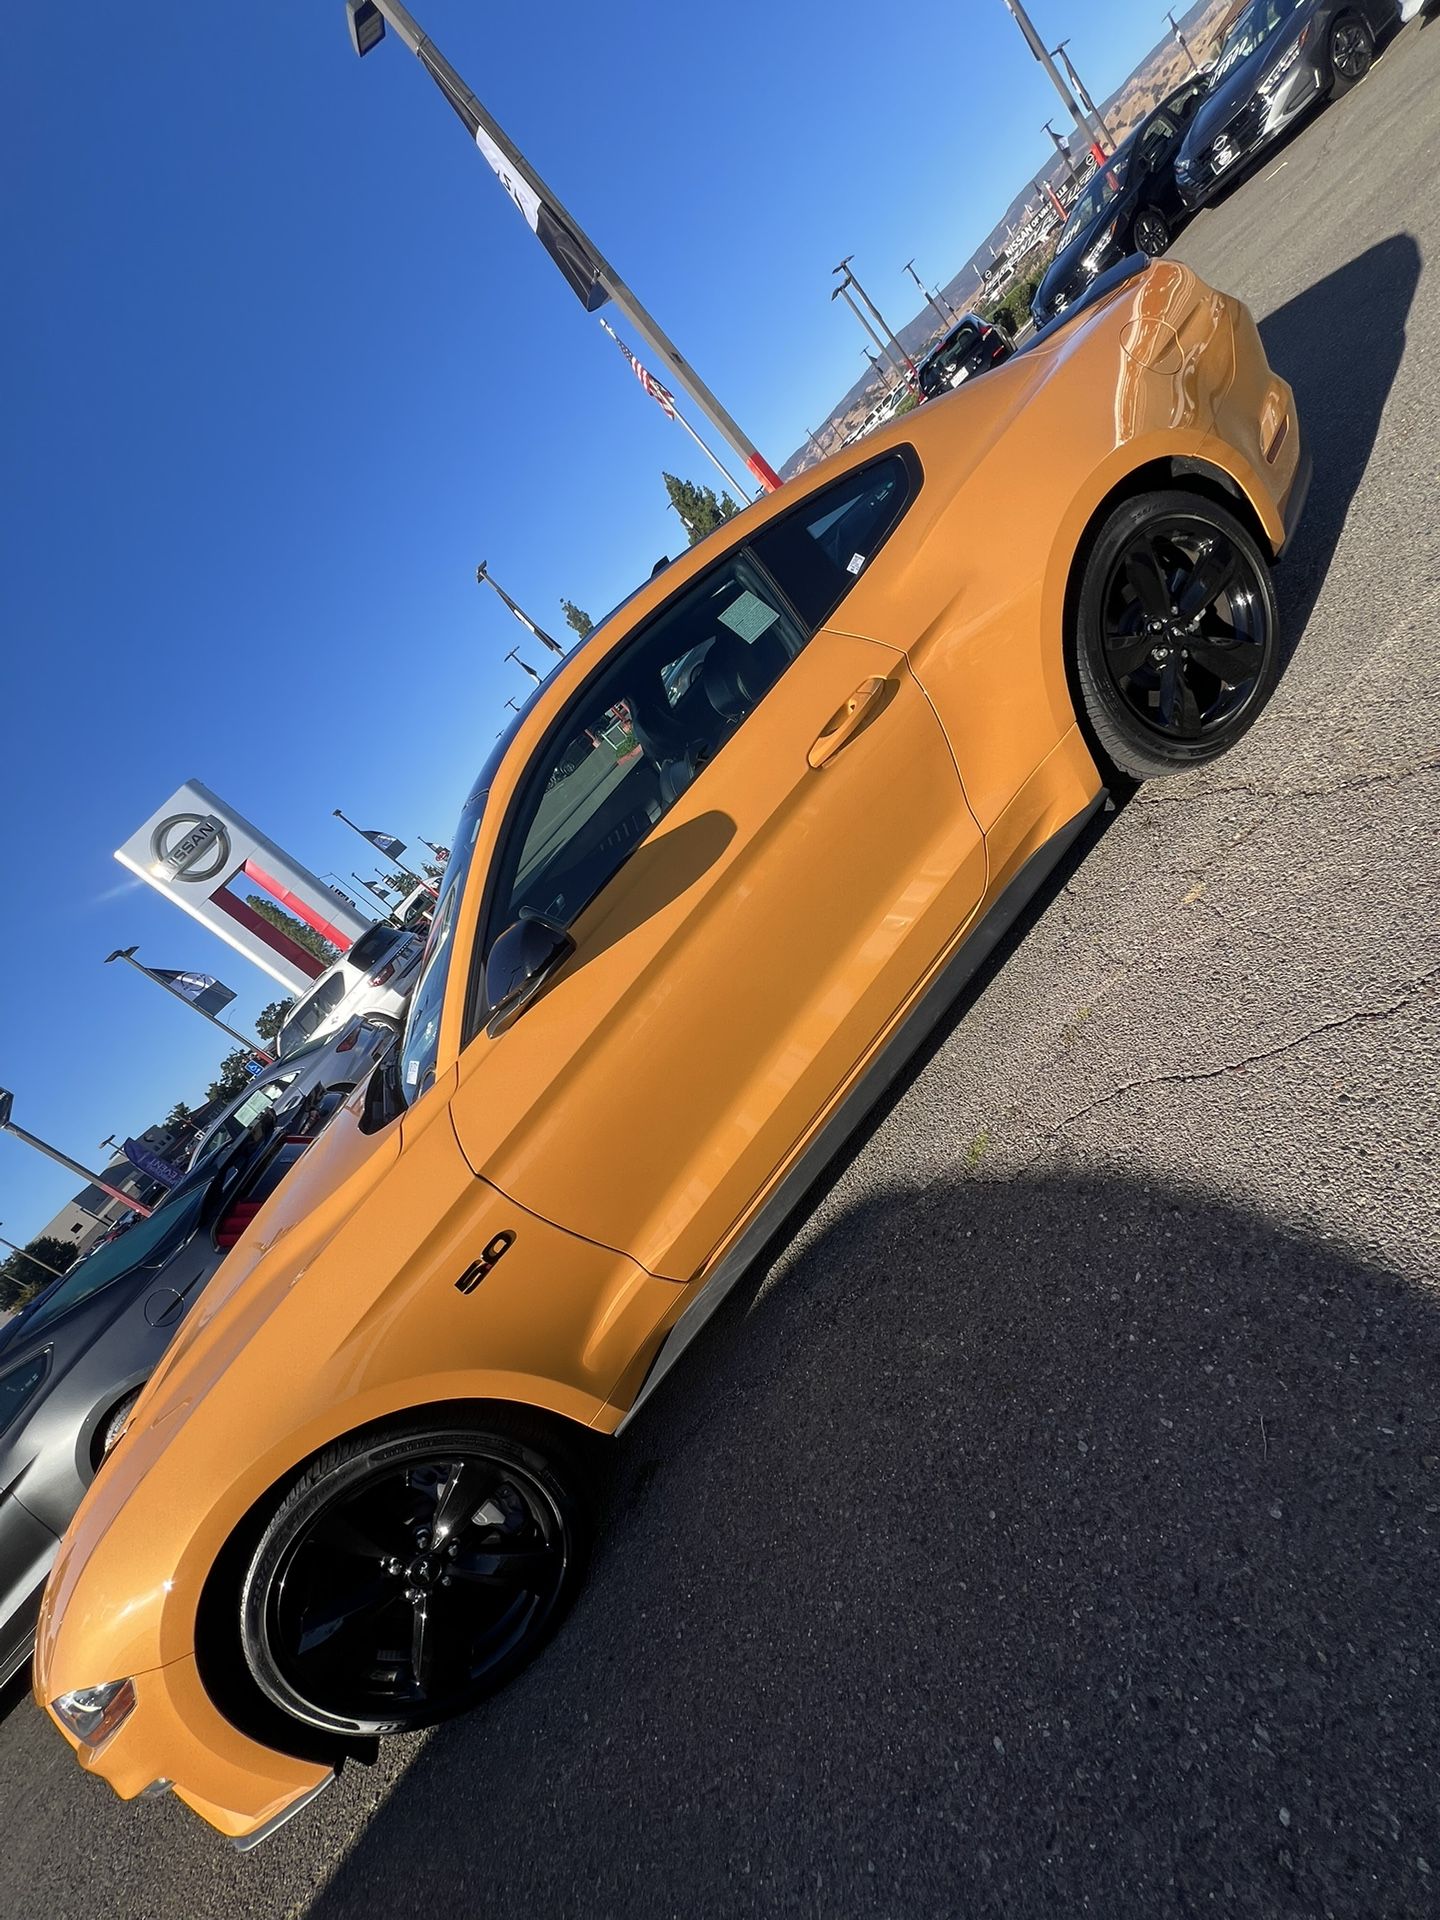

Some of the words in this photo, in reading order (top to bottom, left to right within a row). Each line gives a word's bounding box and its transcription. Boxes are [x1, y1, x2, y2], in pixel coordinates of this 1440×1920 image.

[1004, 223, 1033, 258] NISSAN
[1030, 215, 1041, 228] OF
[150, 1158, 178, 1179] EVENT
